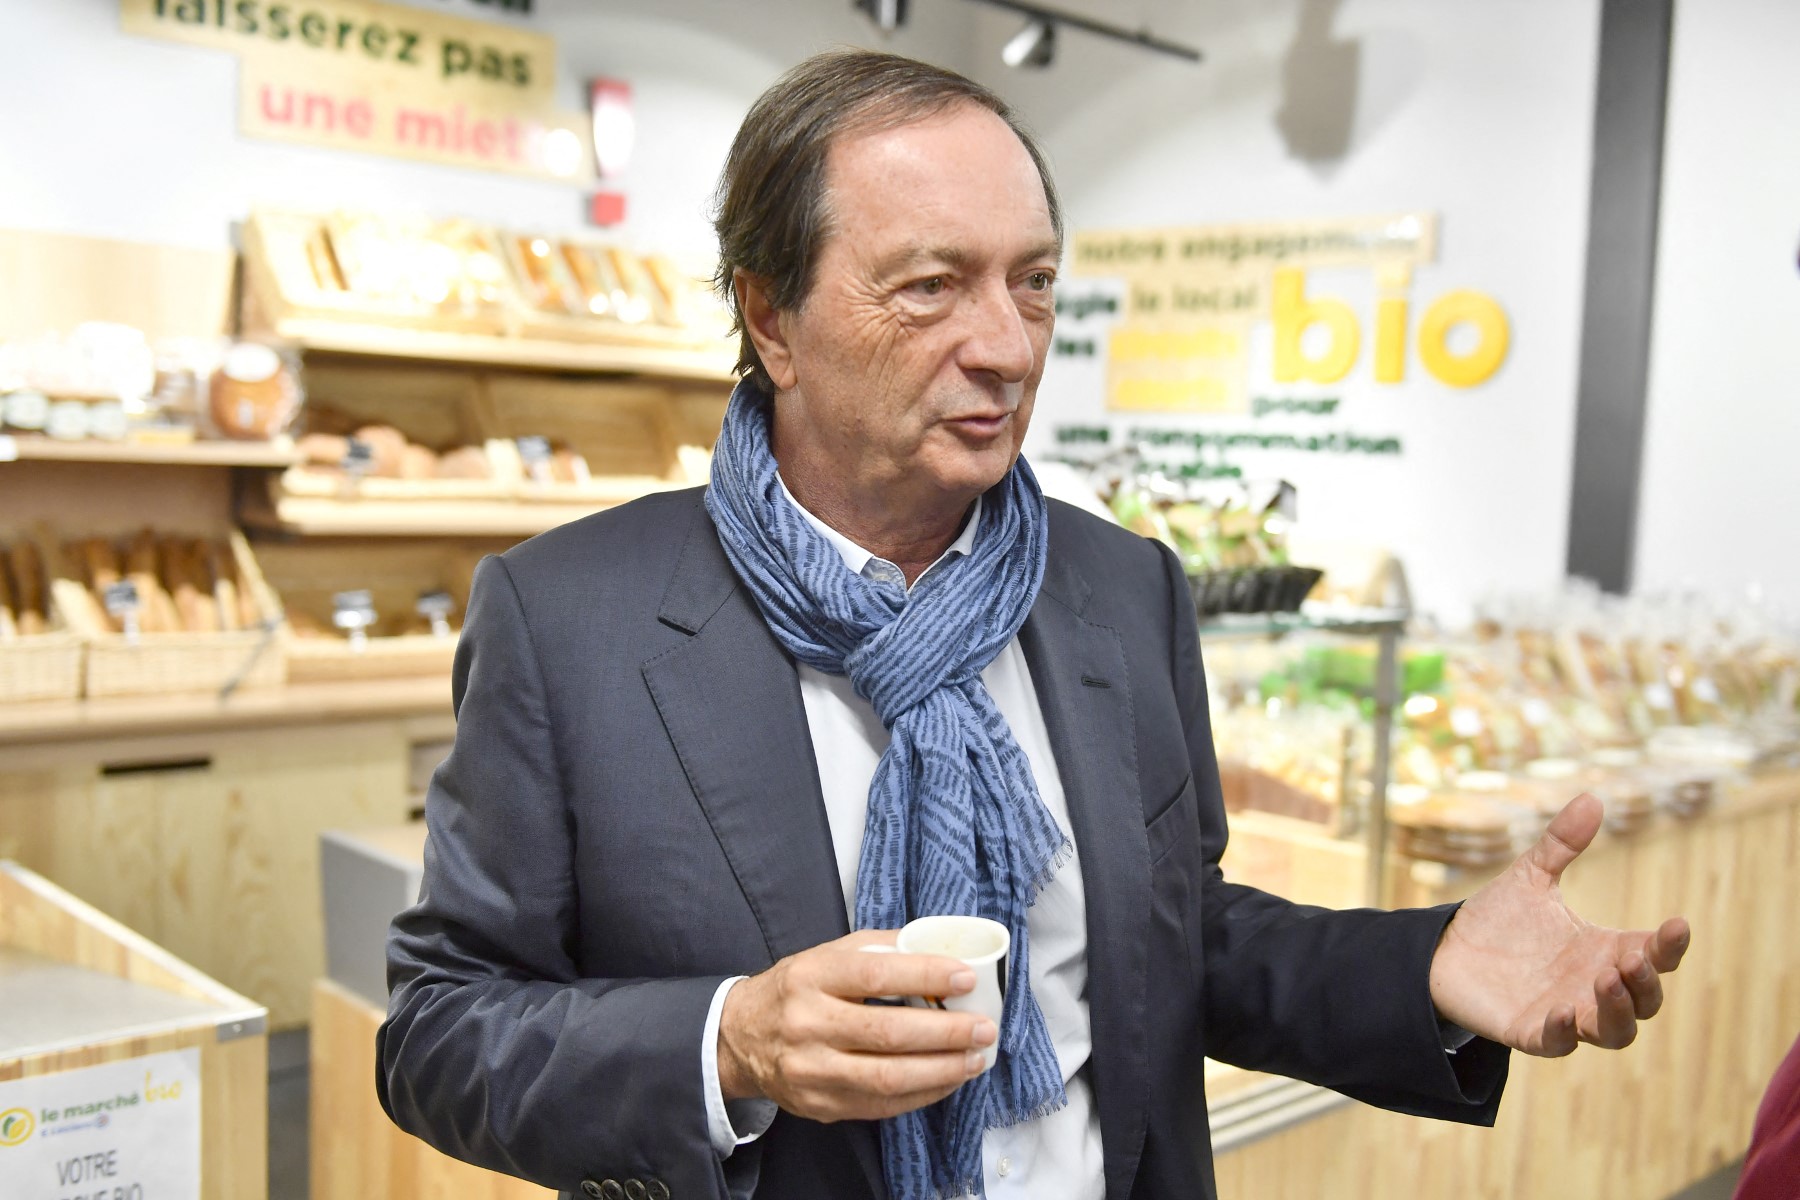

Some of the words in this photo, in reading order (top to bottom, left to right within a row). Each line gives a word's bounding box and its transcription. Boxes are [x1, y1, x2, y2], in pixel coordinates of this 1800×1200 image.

[440, 34, 532, 88] pas
[259, 84, 374, 137] une
[396, 100, 582, 177] miet
[1271, 264, 1511, 389] bio
[40, 1107, 59, 1124] le
[63, 1091, 140, 1119] marché
[56, 1150, 118, 1187] VOTRE
